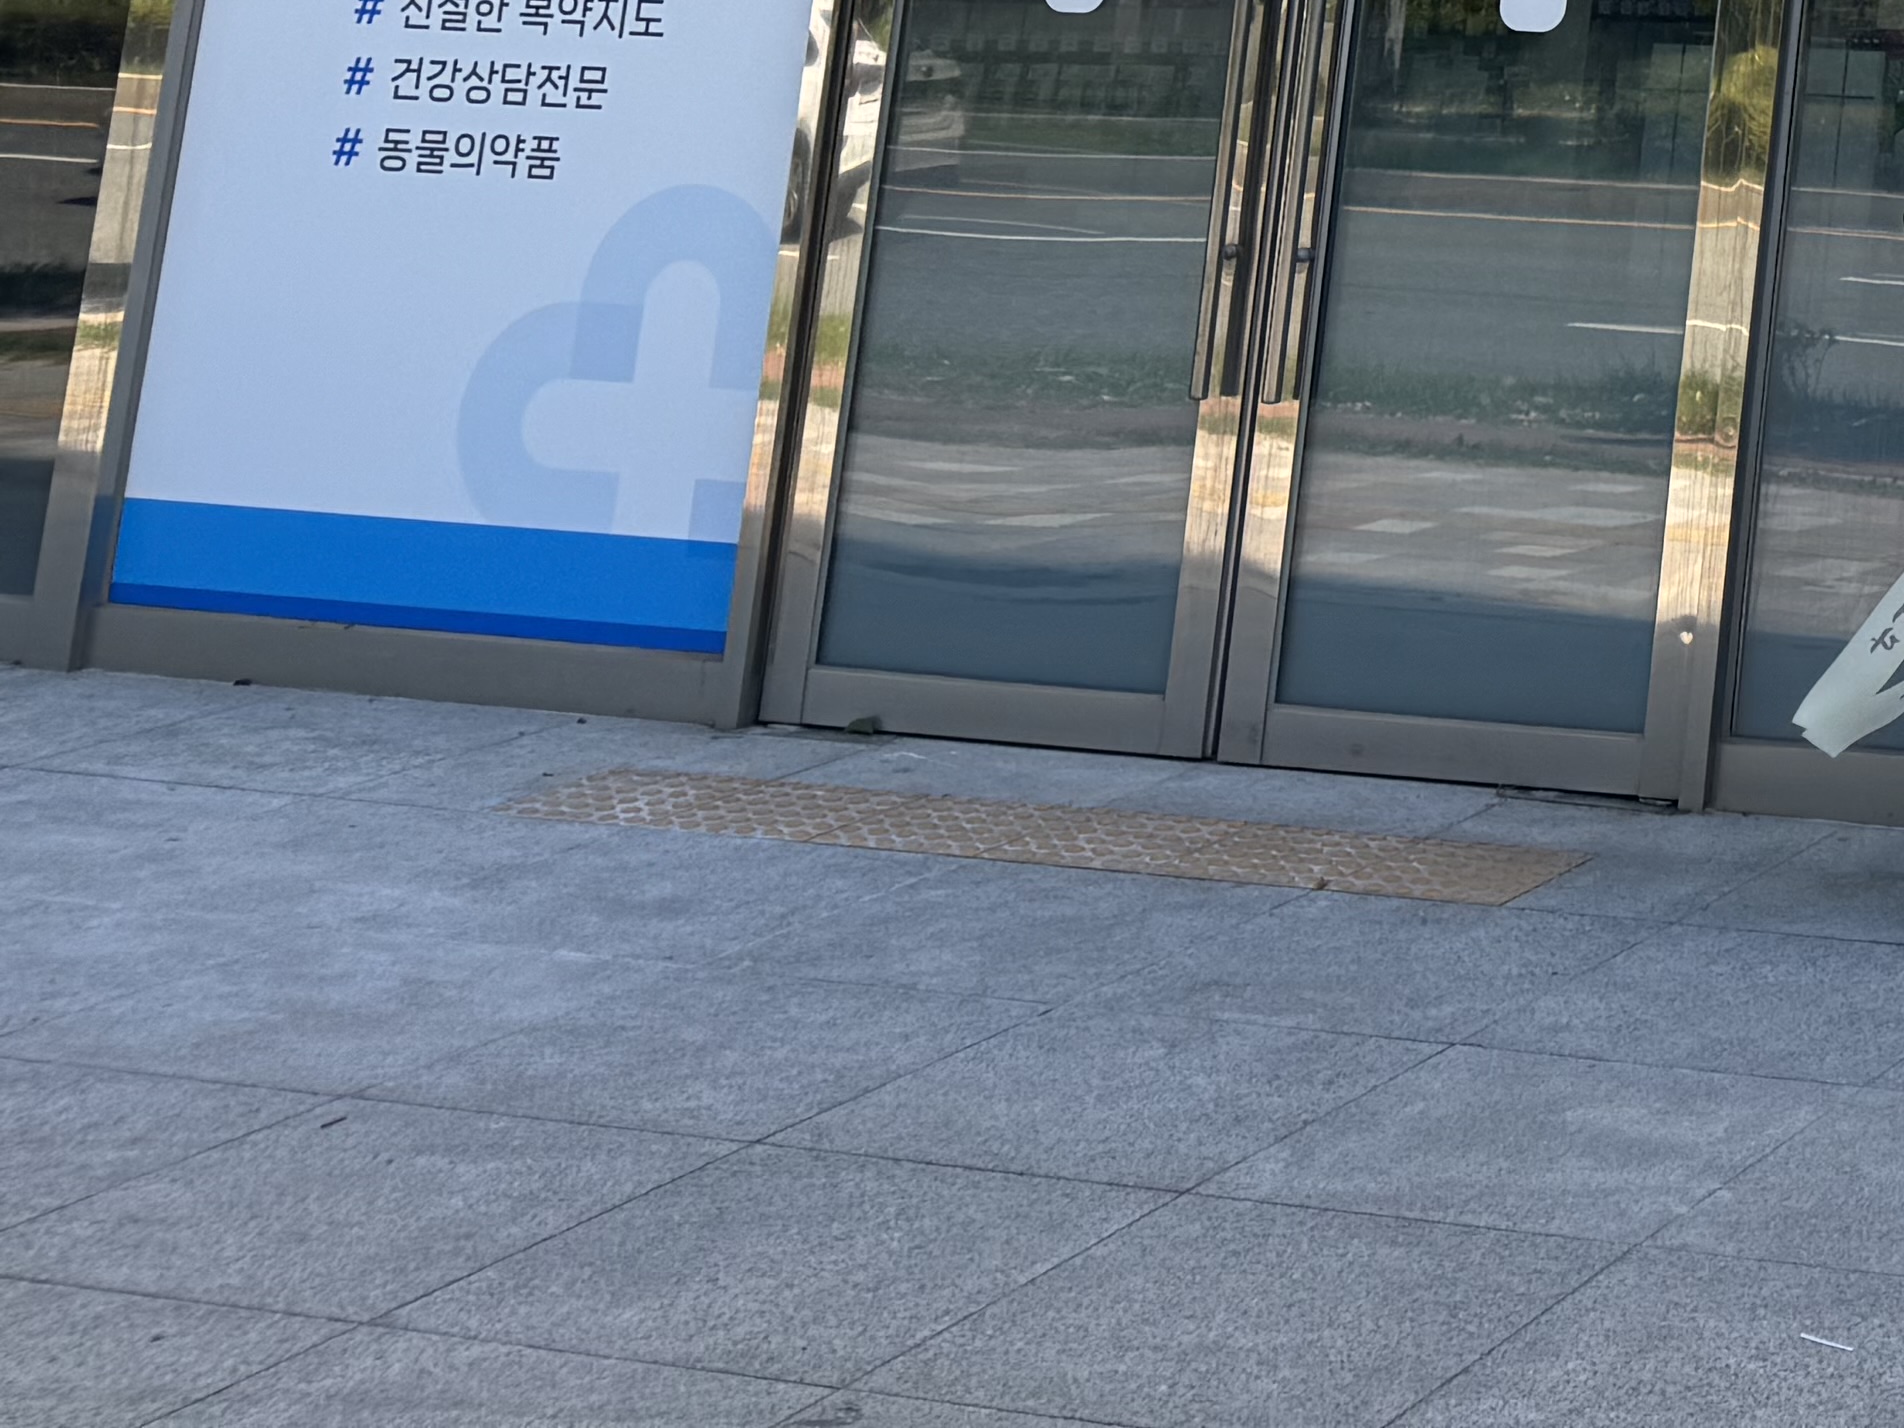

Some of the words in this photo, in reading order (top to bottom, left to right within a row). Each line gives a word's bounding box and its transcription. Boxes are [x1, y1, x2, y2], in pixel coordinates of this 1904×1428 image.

[343, 56, 374, 95] #
[390, 56, 609, 110] 건강상담전문
[332, 127, 363, 167] #
[377, 127, 561, 180] 동물의약품
